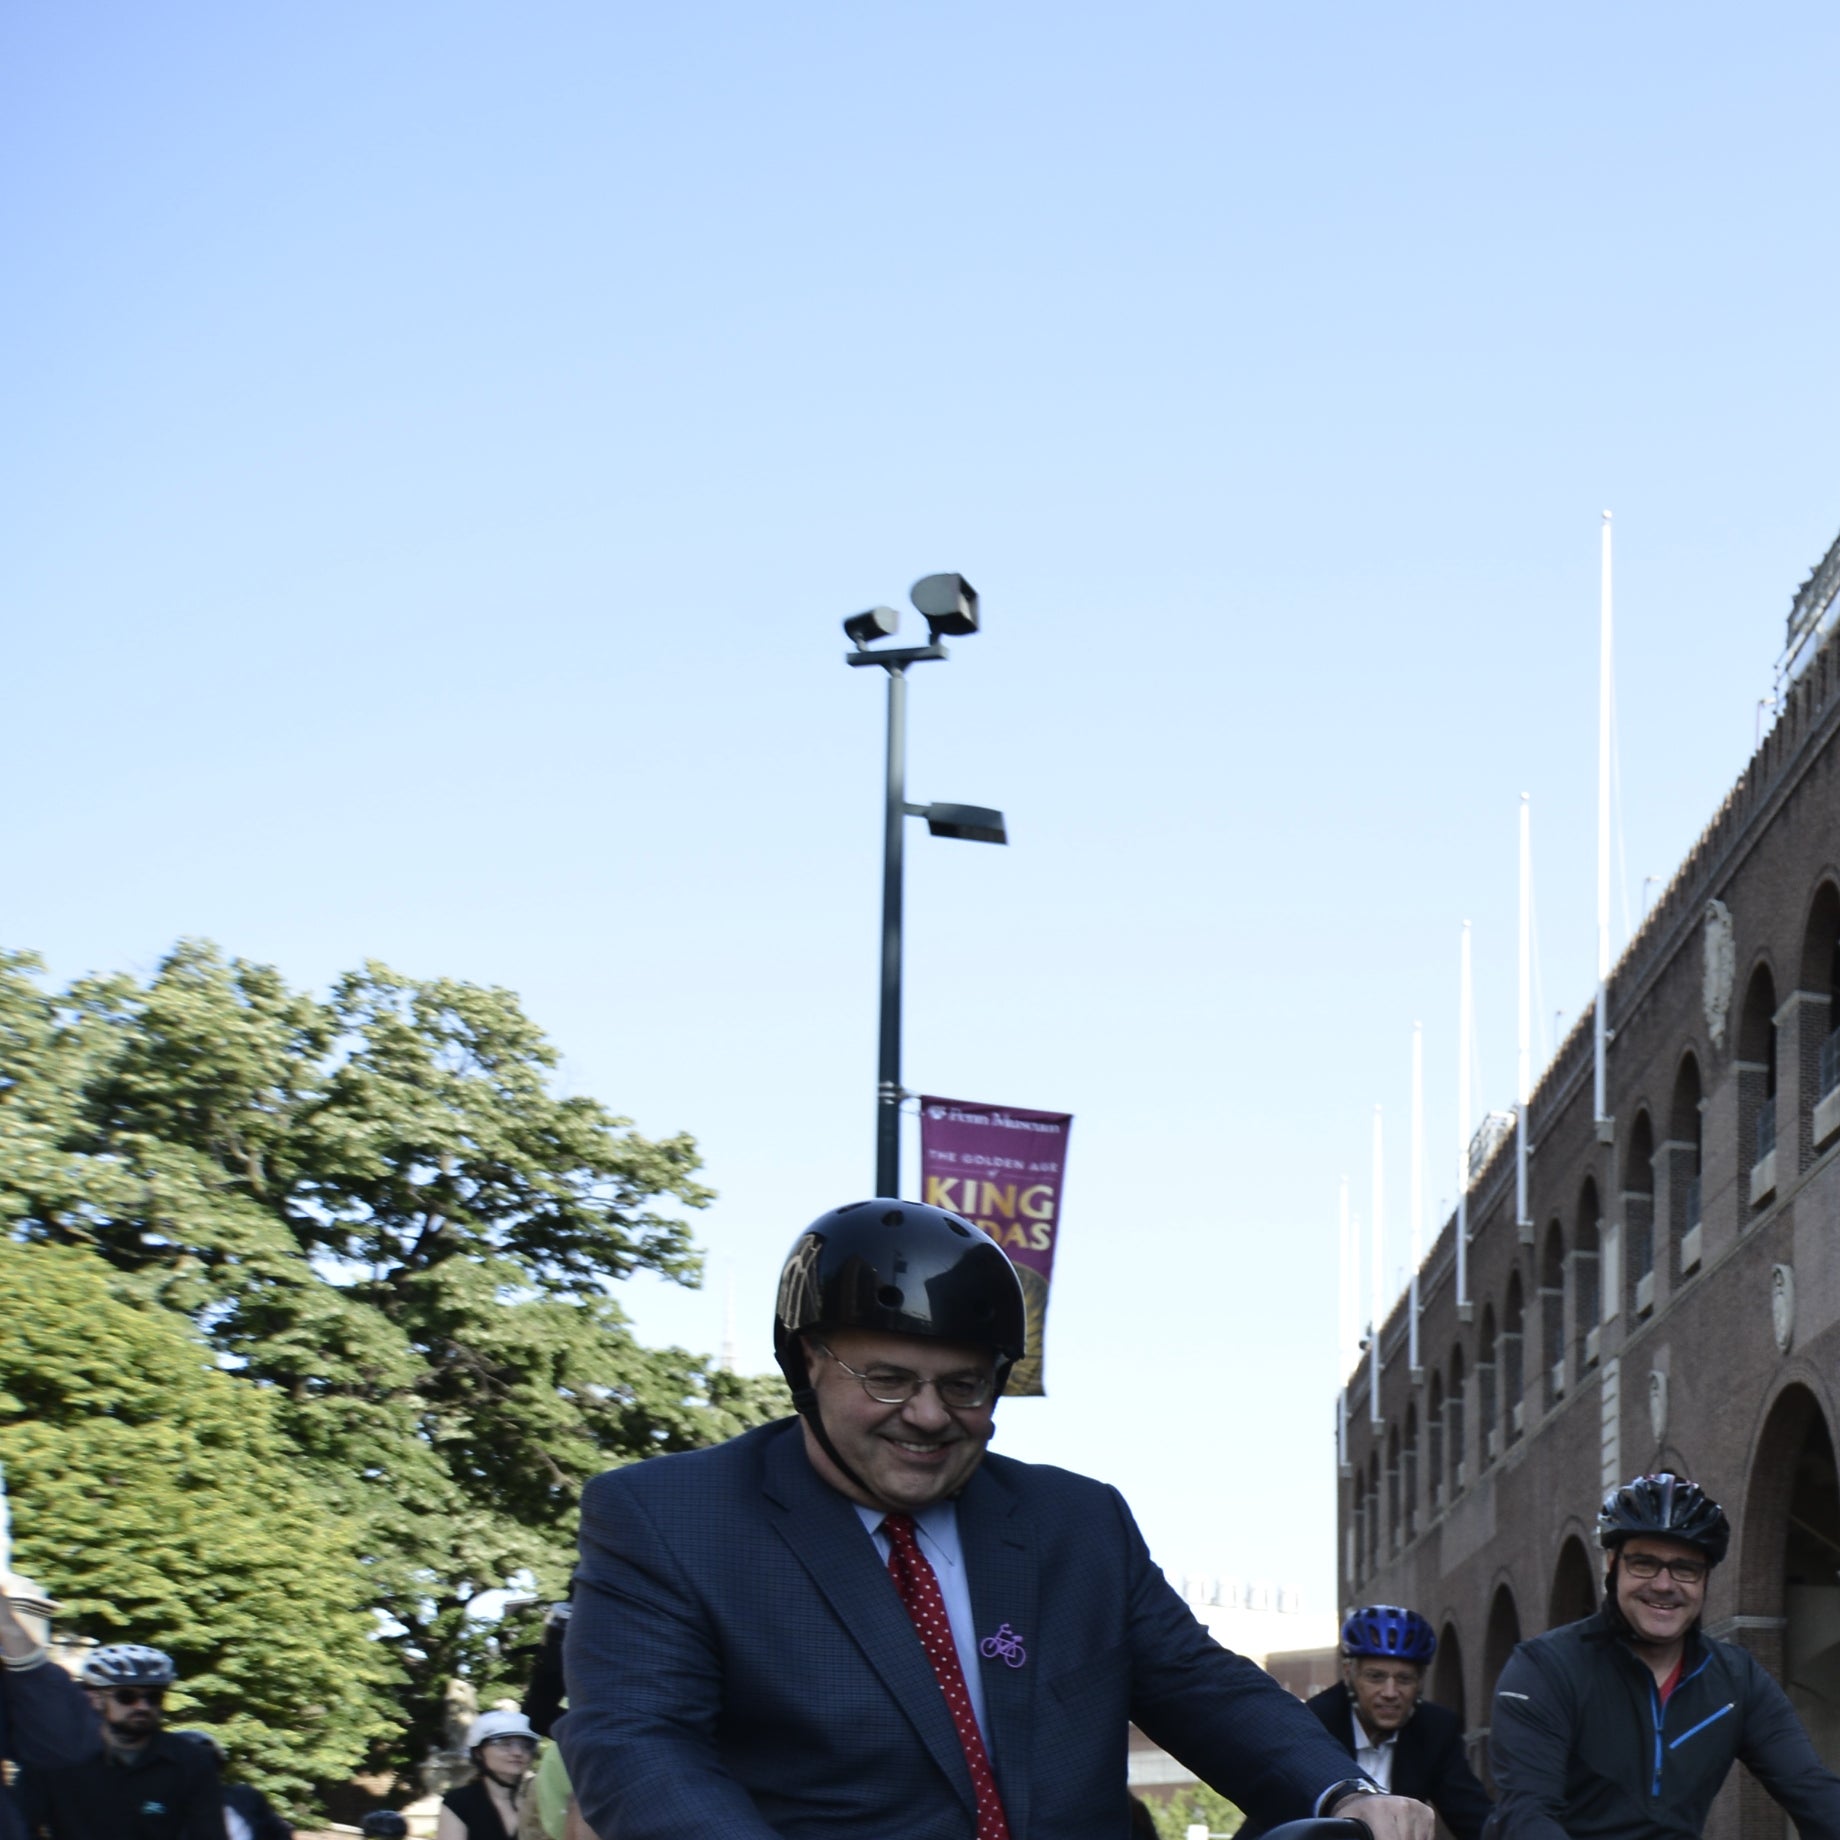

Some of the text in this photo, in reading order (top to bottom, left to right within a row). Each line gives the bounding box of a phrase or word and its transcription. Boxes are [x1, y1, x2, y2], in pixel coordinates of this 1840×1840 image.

[950, 1107, 1060, 1134] Penn Museum
[928, 1149, 1059, 1173] THE GOLDEN AGE
[925, 1175, 1054, 1220] KING
[971, 1217, 1051, 1251] DAS
